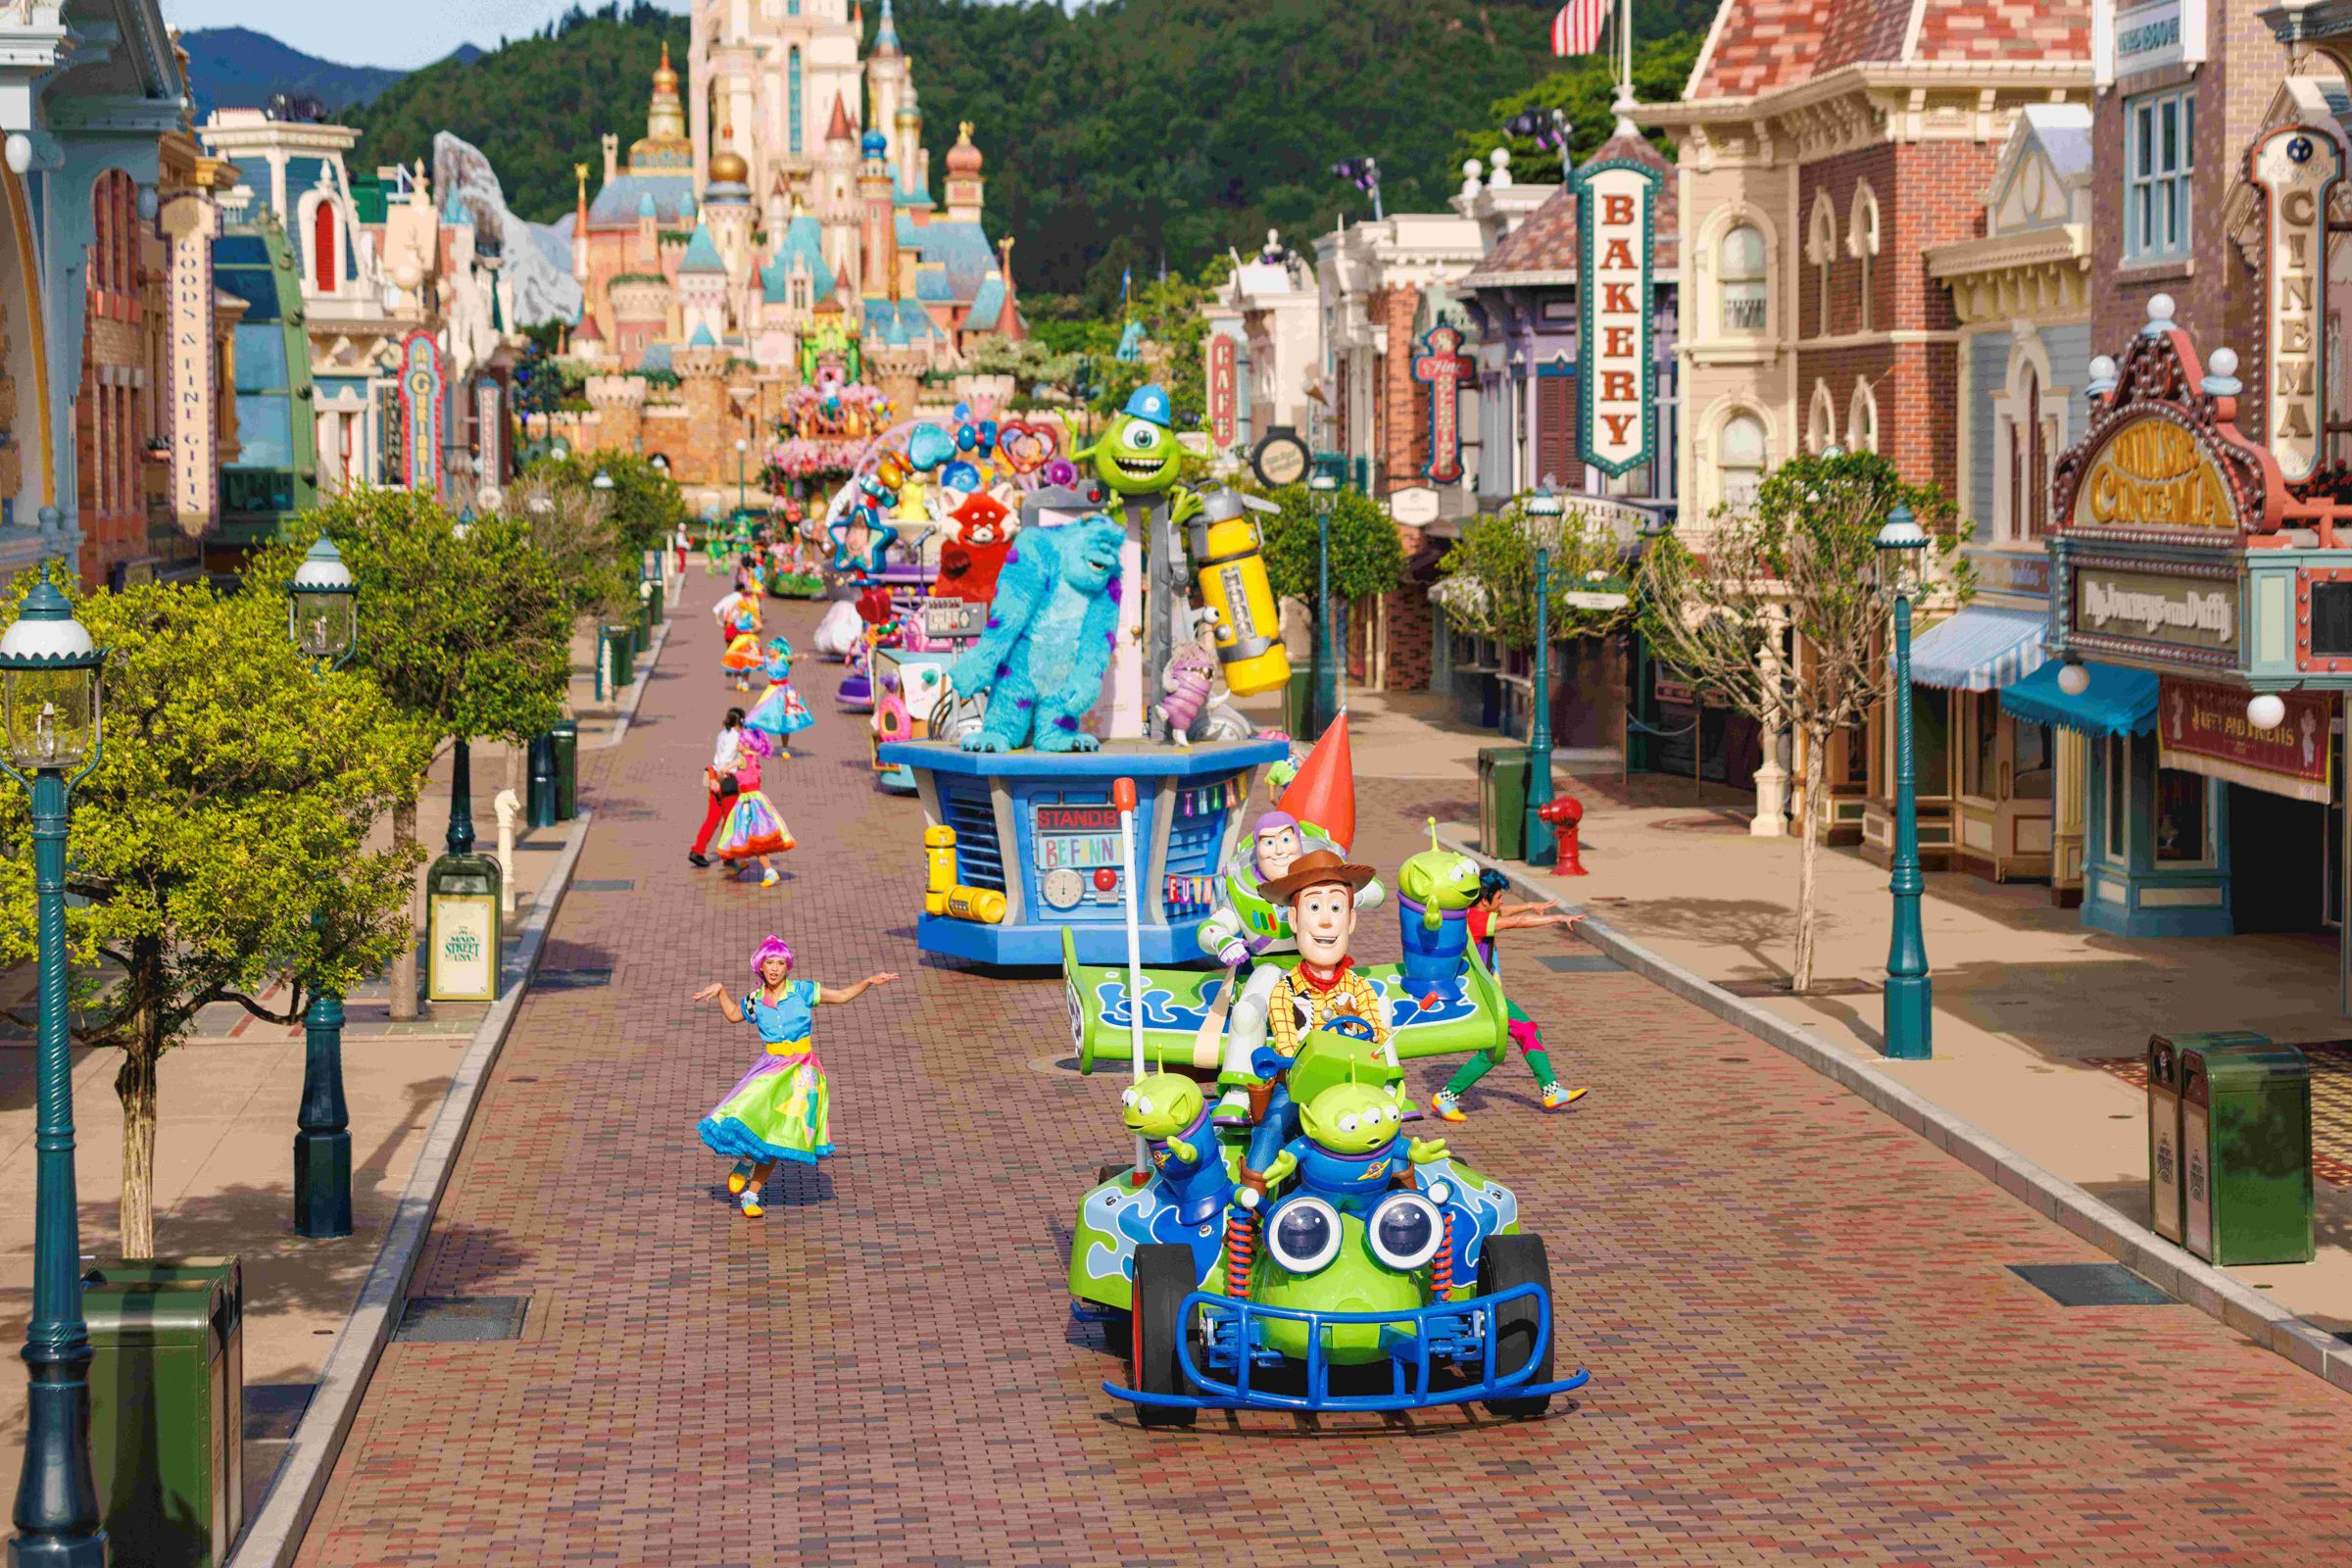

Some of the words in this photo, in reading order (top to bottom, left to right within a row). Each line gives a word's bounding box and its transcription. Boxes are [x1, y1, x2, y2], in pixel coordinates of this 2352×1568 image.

[179, 239, 197, 319] GOODS
[1600, 194, 1639, 446] BAKERY
[2277, 189, 2315, 437] CINEMA
[184, 358, 200, 420] FINE
[1216, 344, 1230, 438] CAFE
[183, 432, 201, 512] GIFTS
[2089, 461, 2236, 527] CINEMA
[2186, 590, 2233, 642] Duffy
[1038, 808, 1121, 827] STANDB
[1046, 838, 1066, 867] BE
[1070, 836, 1124, 865] FUNNY
[445, 942, 479, 957] STREET
